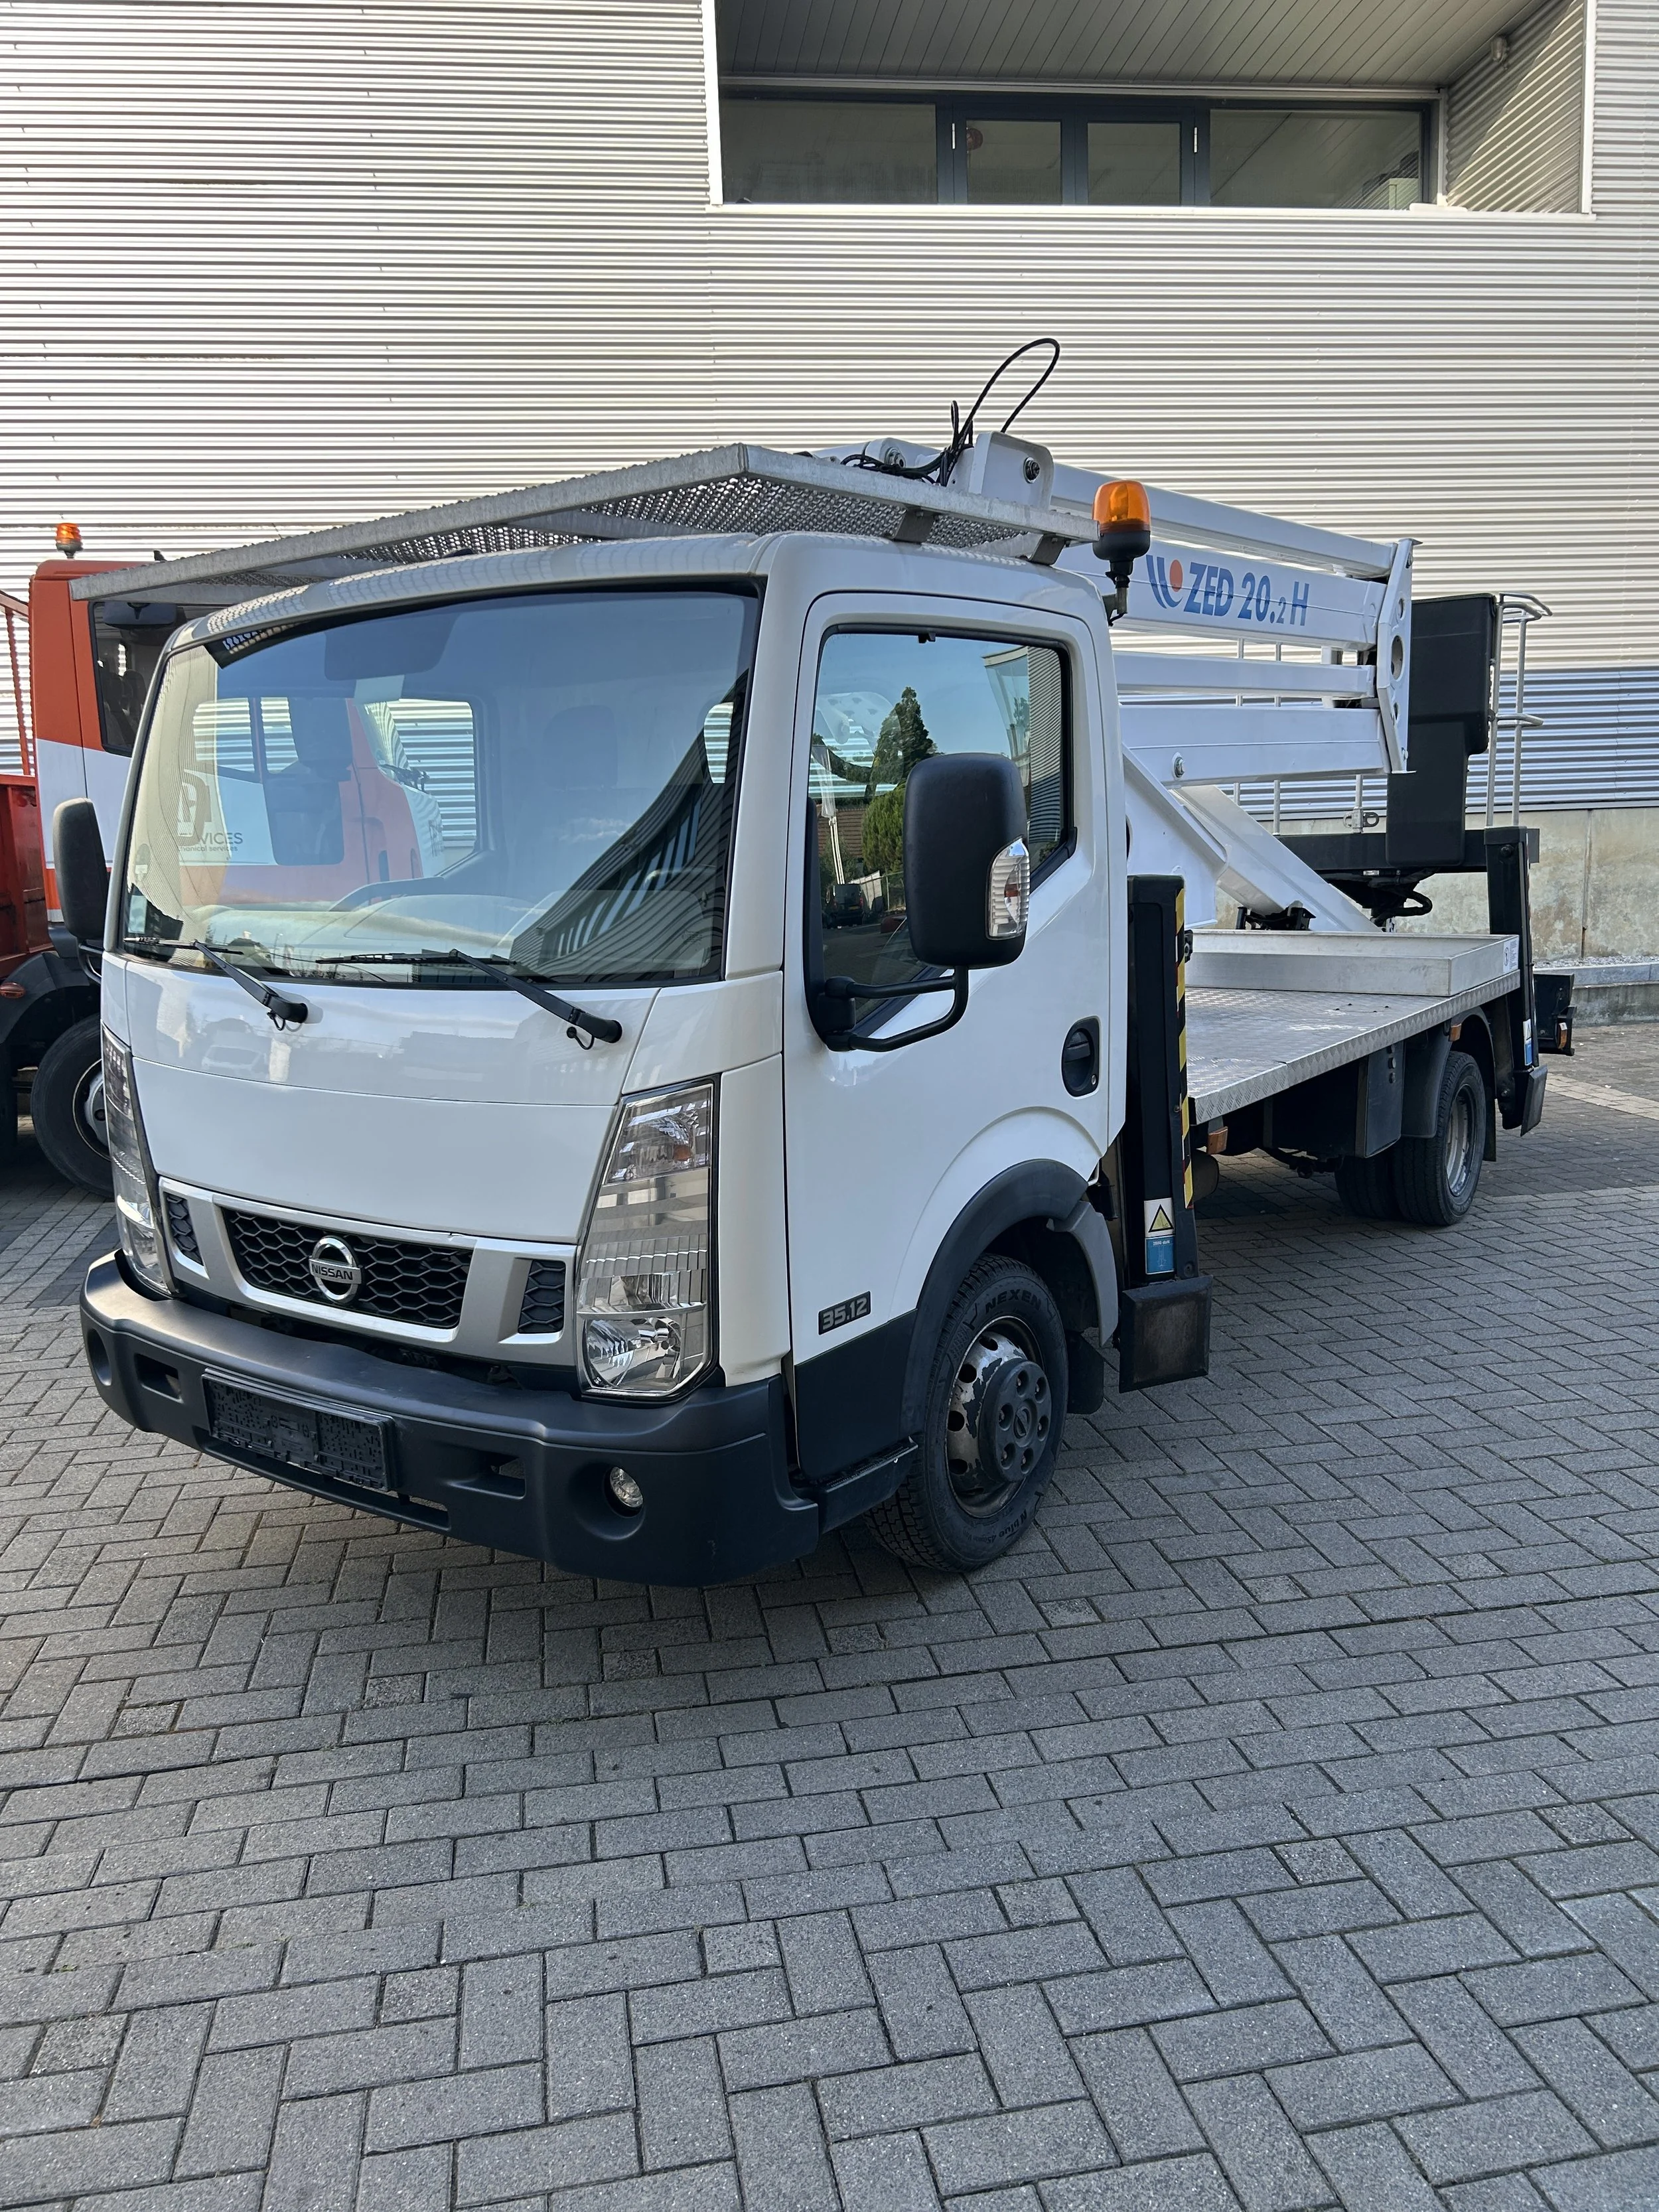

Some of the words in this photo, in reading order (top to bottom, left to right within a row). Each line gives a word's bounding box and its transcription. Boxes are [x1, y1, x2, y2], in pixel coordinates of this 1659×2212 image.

[1183, 561, 1234, 617] ZED
[1238, 572, 1286, 625] 20.2
[1290, 581, 1309, 627] H
[311, 1263, 353, 1281] NISSAN
[822, 1297, 867, 1330] 35.12
[985, 1288, 1042, 1314] NEXEN
[999, 1518, 1020, 1538] blue
